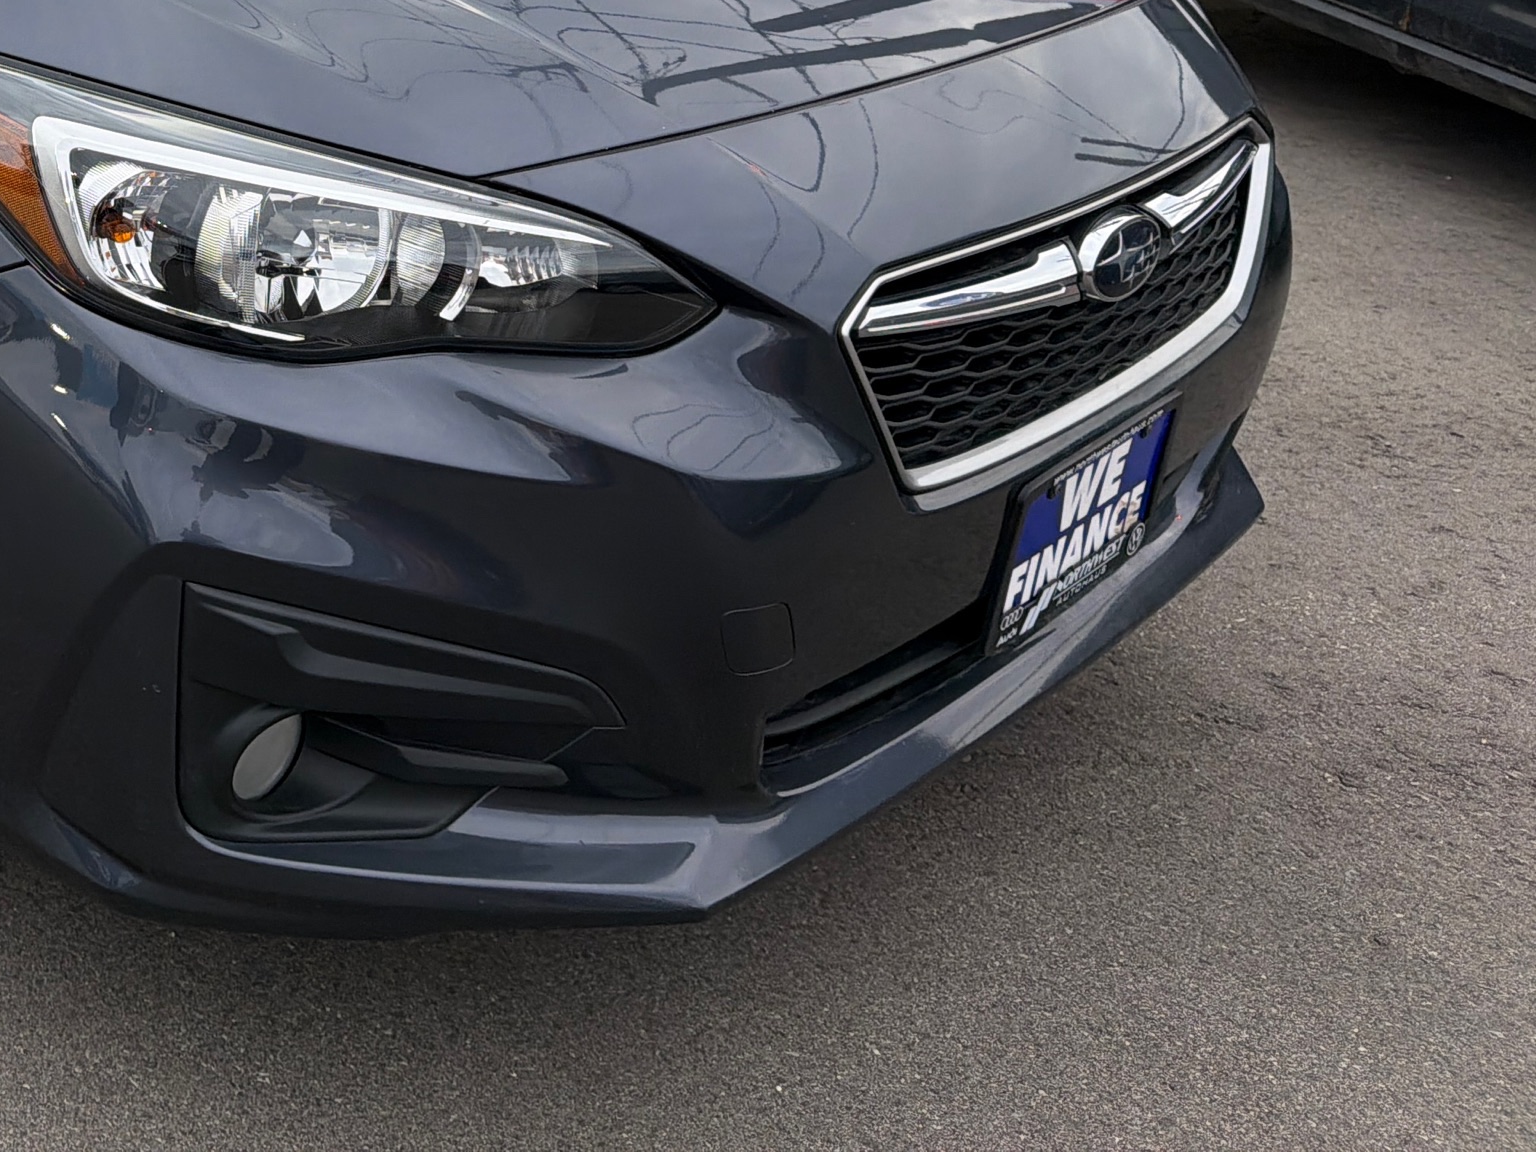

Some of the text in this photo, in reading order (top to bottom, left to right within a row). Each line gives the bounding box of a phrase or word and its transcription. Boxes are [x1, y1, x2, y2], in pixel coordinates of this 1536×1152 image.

[1060, 438, 1133, 532] WE
[1003, 479, 1147, 614] FINANCE
[1053, 533, 1127, 593] NORTHWEST
[1055, 564, 1108, 607] AUTOHAUS
